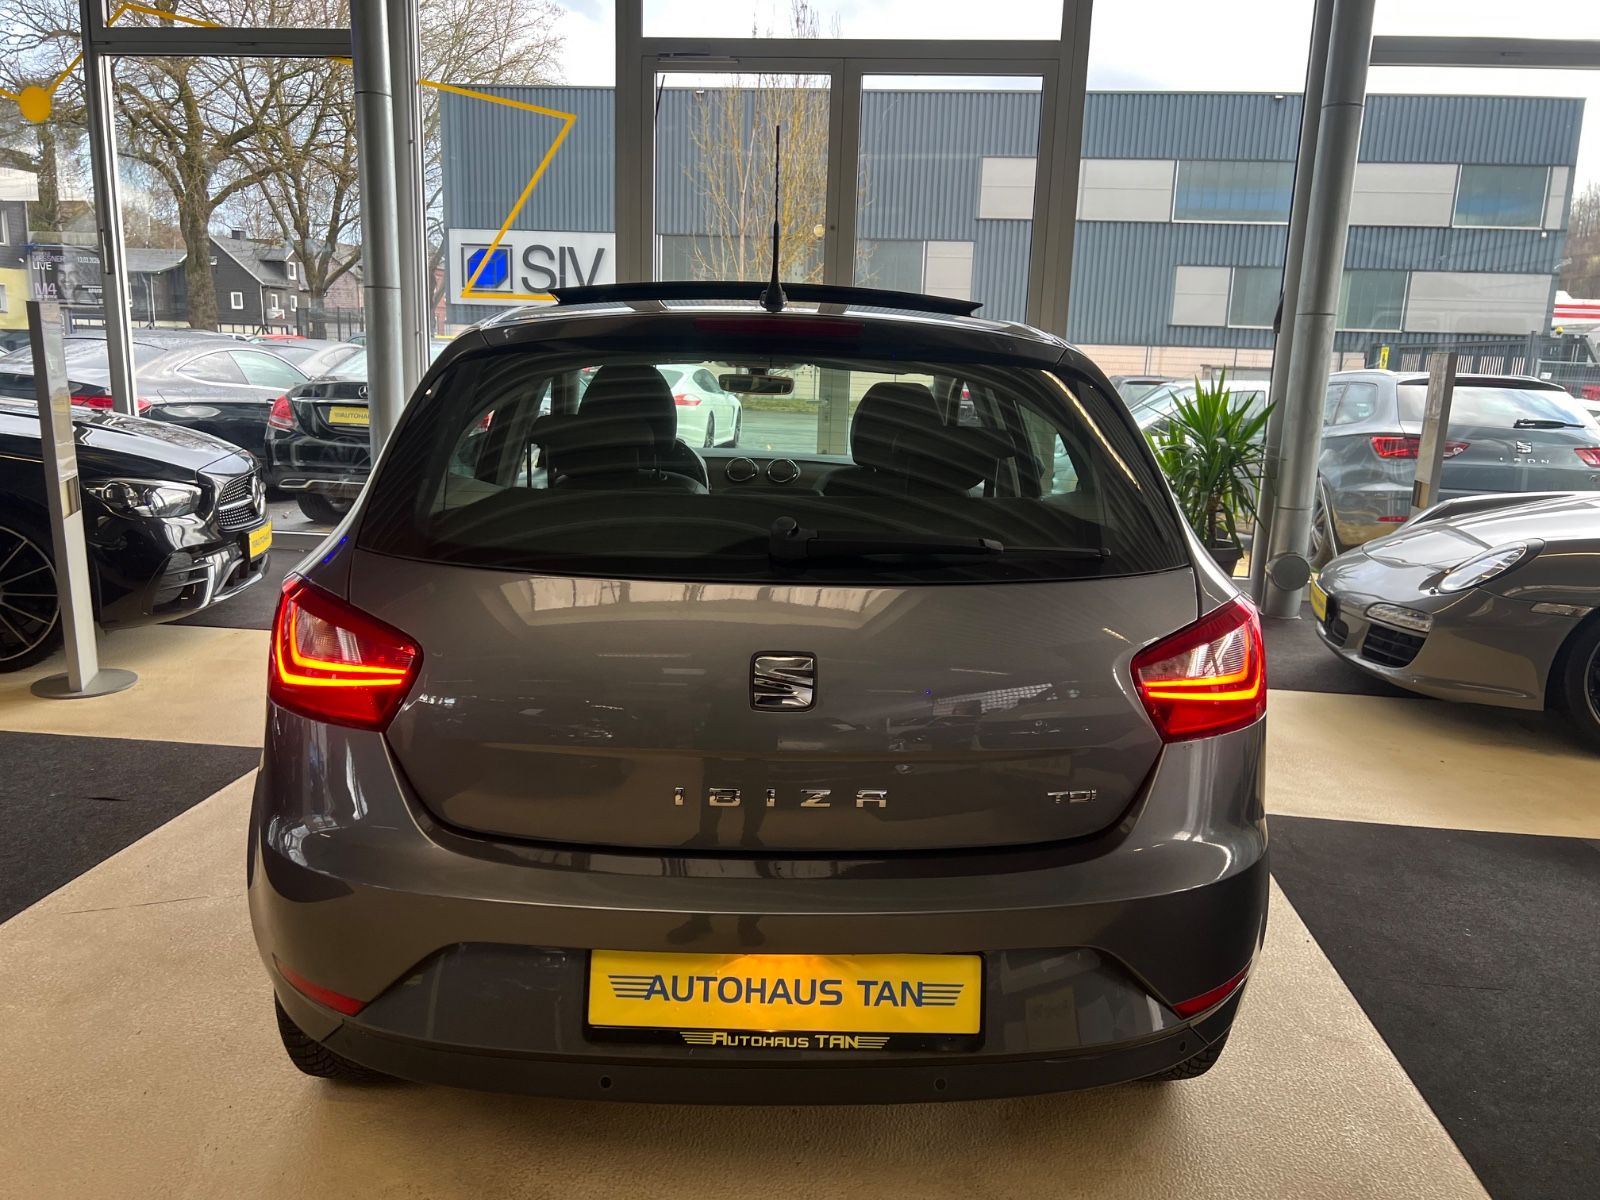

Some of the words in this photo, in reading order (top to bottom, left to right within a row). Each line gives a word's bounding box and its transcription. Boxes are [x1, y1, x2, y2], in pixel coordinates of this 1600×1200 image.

[32, 261, 52, 271] LIVE
[521, 244, 606, 294] SIV
[34, 282, 57, 295] M4
[644, 974, 843, 1006] AUTOHAUS
[857, 980, 923, 1007] TAN
[815, 1034, 859, 1049] TAN
